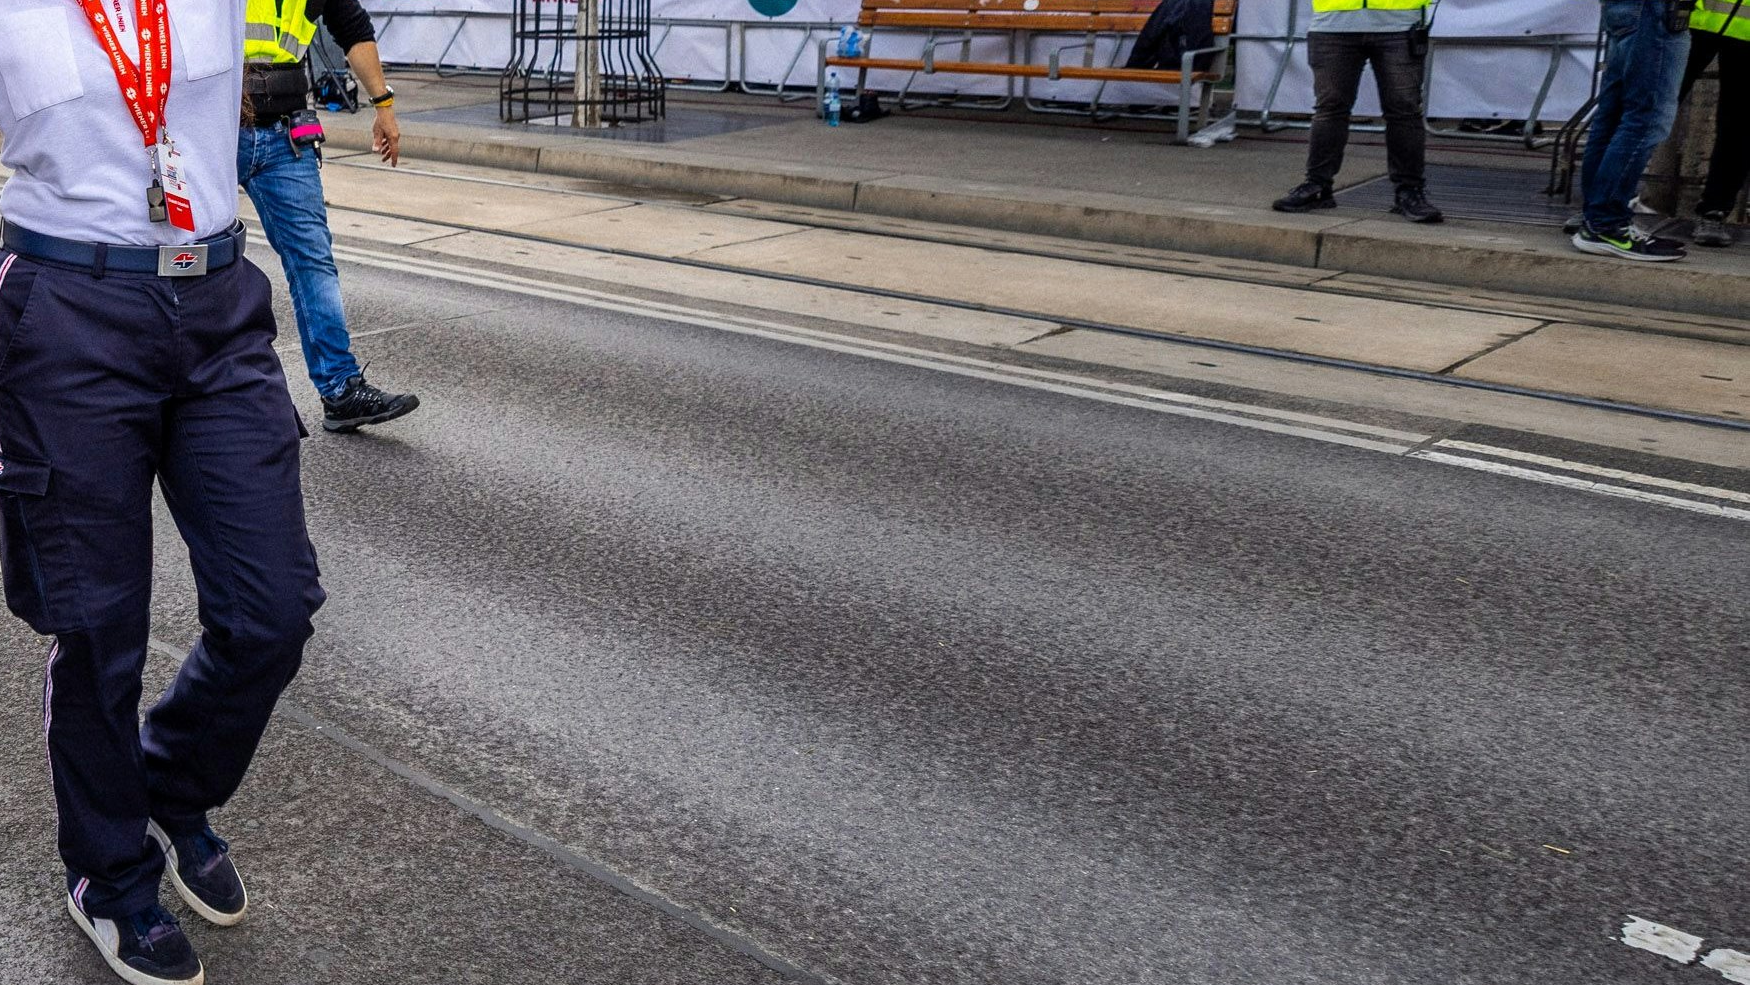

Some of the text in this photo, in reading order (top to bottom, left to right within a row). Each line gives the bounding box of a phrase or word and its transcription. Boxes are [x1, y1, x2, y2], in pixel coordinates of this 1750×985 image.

[116, 12, 126, 33] LINIEN
[157, 17, 168, 70] WIENER LINIEN
[102, 25, 127, 76] WIENER LINIEN
[144, 43, 153, 98] WIENER LINIEN
[132, 101, 149, 130] WIENER
